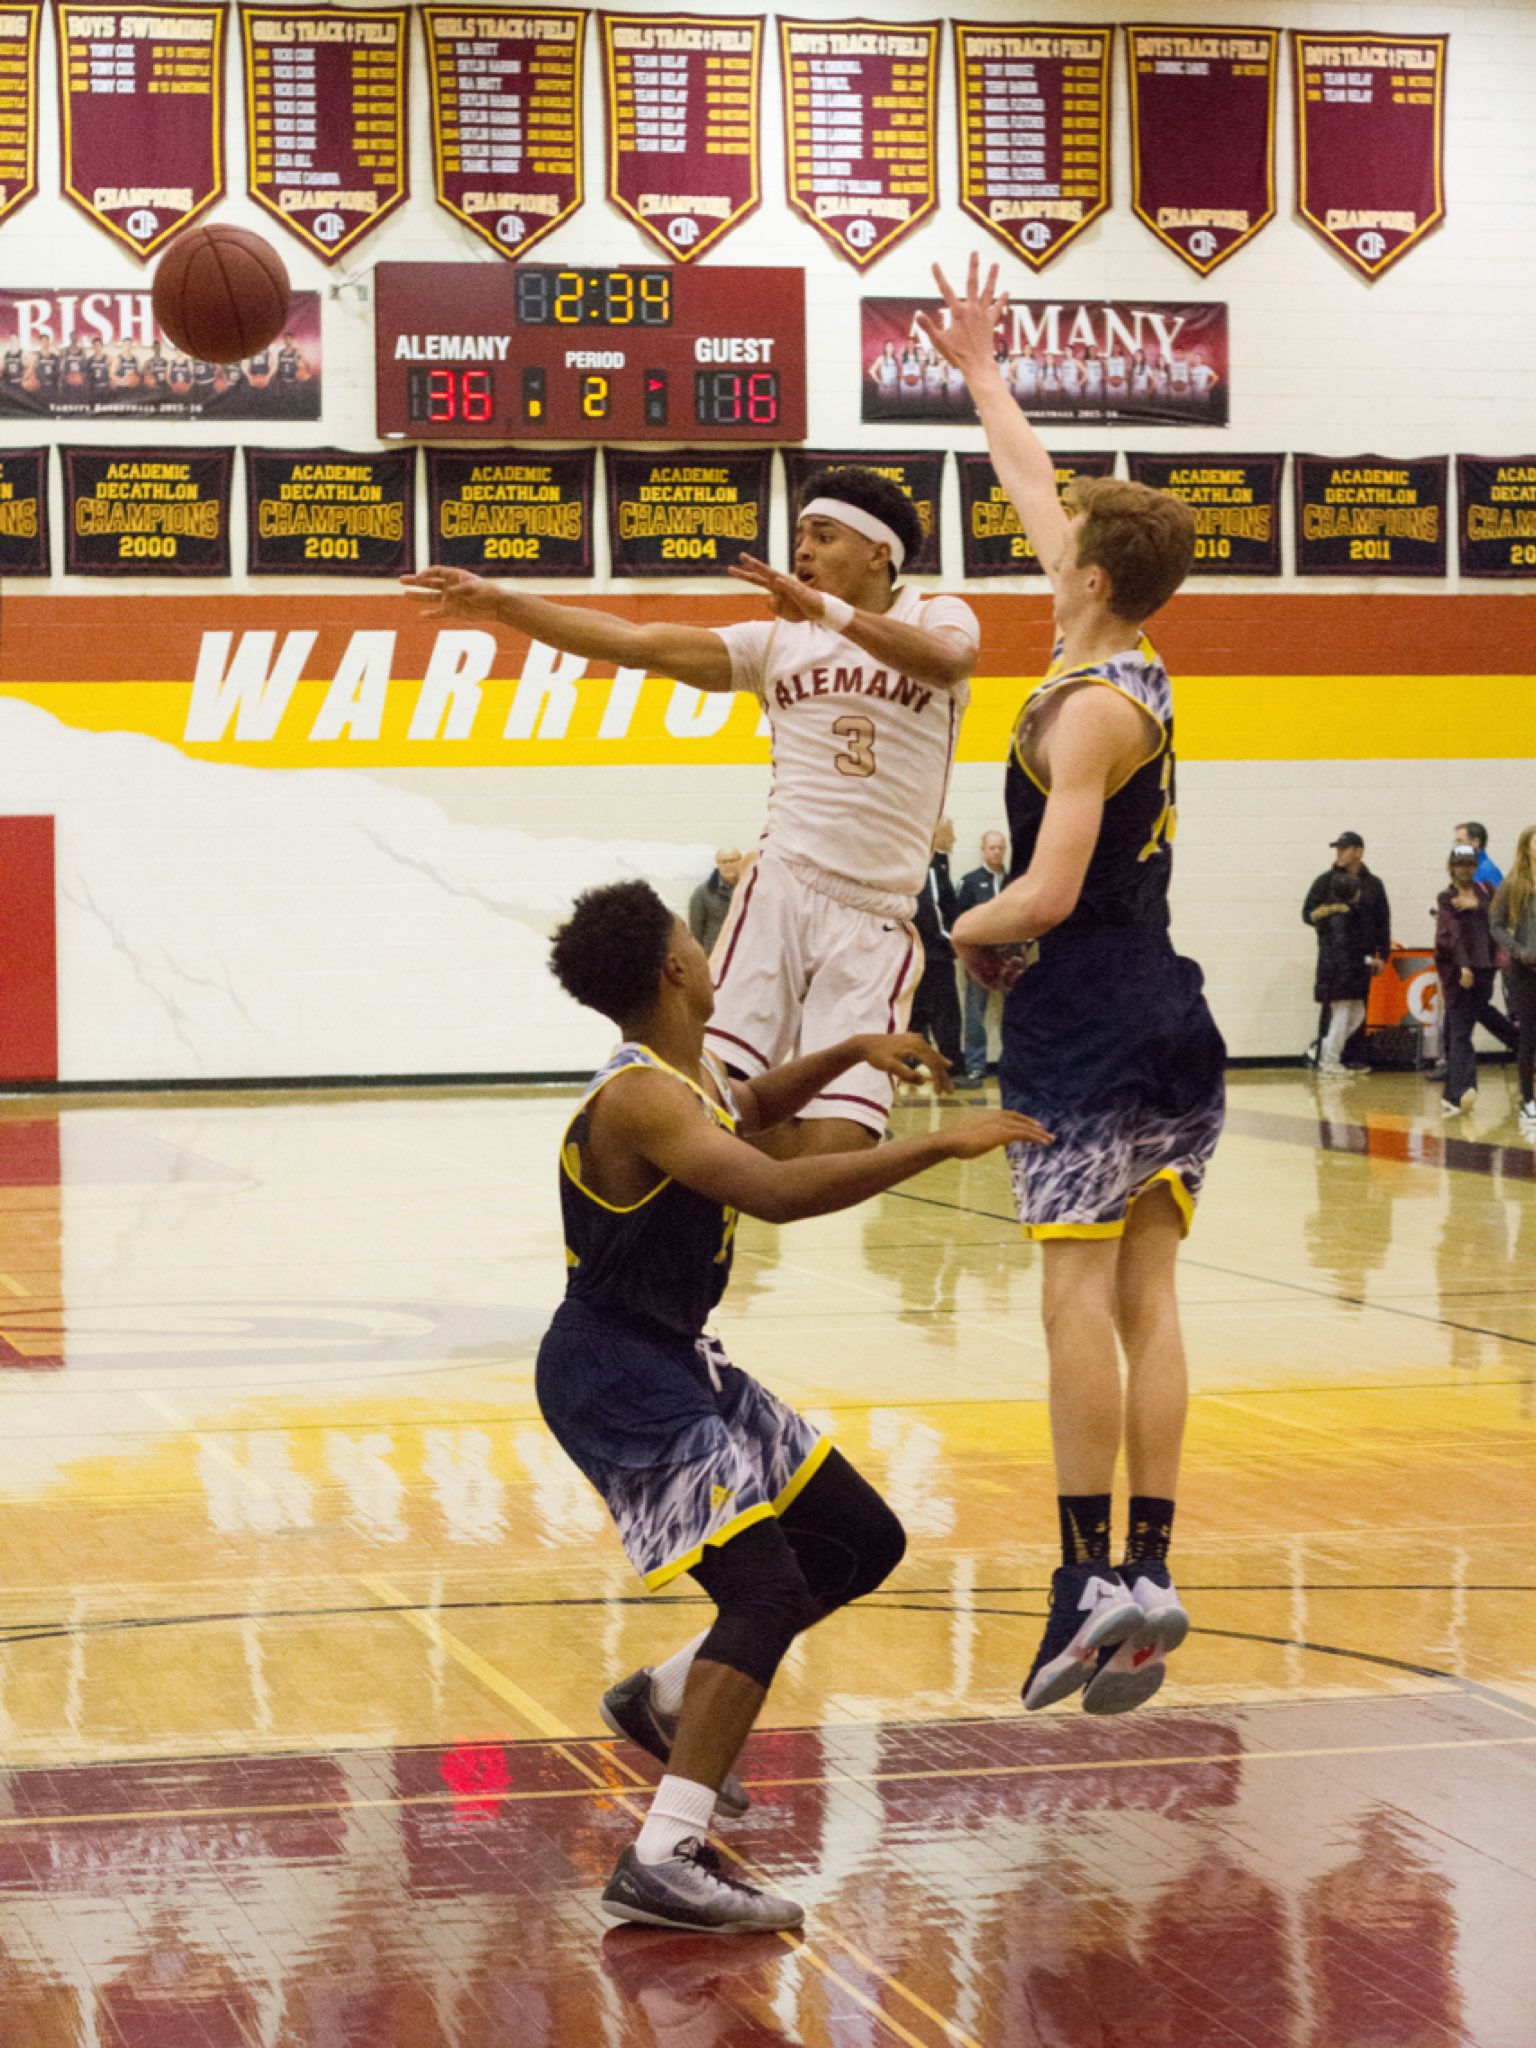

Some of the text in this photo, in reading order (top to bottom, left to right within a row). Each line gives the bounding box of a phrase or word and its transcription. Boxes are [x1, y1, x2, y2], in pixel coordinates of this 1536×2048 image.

[67, 15, 213, 40] BOYS SWIMMING
[296, 21, 345, 42] TRACK
[355, 23, 397, 44] FIELD
[476, 18, 525, 39] TRACK
[534, 20, 576, 40] FIELD
[655, 28, 703, 49] TRACK
[712, 30, 752, 51] FIELD
[829, 33, 878, 55] TRACK
[887, 35, 929, 57] FIELD
[1003, 37, 1052, 58] TRACK
[1061, 38, 1102, 59] FIELD
[1173, 37, 1221, 58] TRACK
[1229, 39, 1269, 60] FIELD
[1341, 46, 1388, 67] TRACK
[1396, 48, 1436, 69] FIELD
[94, 187, 193, 212] CHAMPIONS
[280, 190, 378, 214] CHAMPIONS
[462, 192, 560, 216] CHAMPIONS
[638, 194, 732, 218] CHAMPIONS
[815, 196, 911, 220] CHAMPIONS
[990, 200, 1083, 222] CHAMPIONS
[1157, 208, 1249, 231] CHAMPIONS
[1326, 209, 1416, 233] CHAMPIONS
[555, 272, 669, 324] 2:34
[13, 293, 183, 352] BISH
[394, 335, 511, 361] ALEMANY
[694, 338, 775, 363] GUEST
[565, 351, 625, 369] PERIOD
[429, 370, 492, 422] 36
[583, 377, 608, 417] 2
[733, 374, 777, 424] 16
[107, 463, 190, 481] ACADEMIC
[291, 466, 372, 482] ACADEMIC
[471, 466, 552, 482] ACADEMIC
[649, 468, 729, 483] ACADEMIC
[1169, 469, 1246, 484] ACADEMIC
[1330, 469, 1409, 485] ACADEMIC
[1496, 467, 1536, 482] ACAD
[96, 483, 199, 500] DECATHLON
[280, 485, 382, 502] DECATHLON
[461, 485, 561, 502] DECATHLON
[639, 486, 738, 502] DECATHLON
[1325, 487, 1417, 504] DECATHLON
[1490, 486, 1536, 502] DECAT
[76, 497, 219, 539] CHAMPIONS
[259, 500, 403, 541] CHAMPIONS
[440, 500, 582, 541] CHAMPIONS
[619, 501, 758, 541] CHAMPIONS
[1303, 503, 1439, 543] CHAMPIONS
[118, 537, 177, 557] 2000
[304, 538, 359, 559] 2001
[484, 538, 539, 559] 2002
[661, 539, 717, 559] 2004
[1193, 538, 1231, 558] 010
[1349, 540, 1392, 560] 2011
[1510, 544, 1536, 565] 20
[774, 666, 933, 714] ALEMANY
[832, 715, 876, 778] 3
